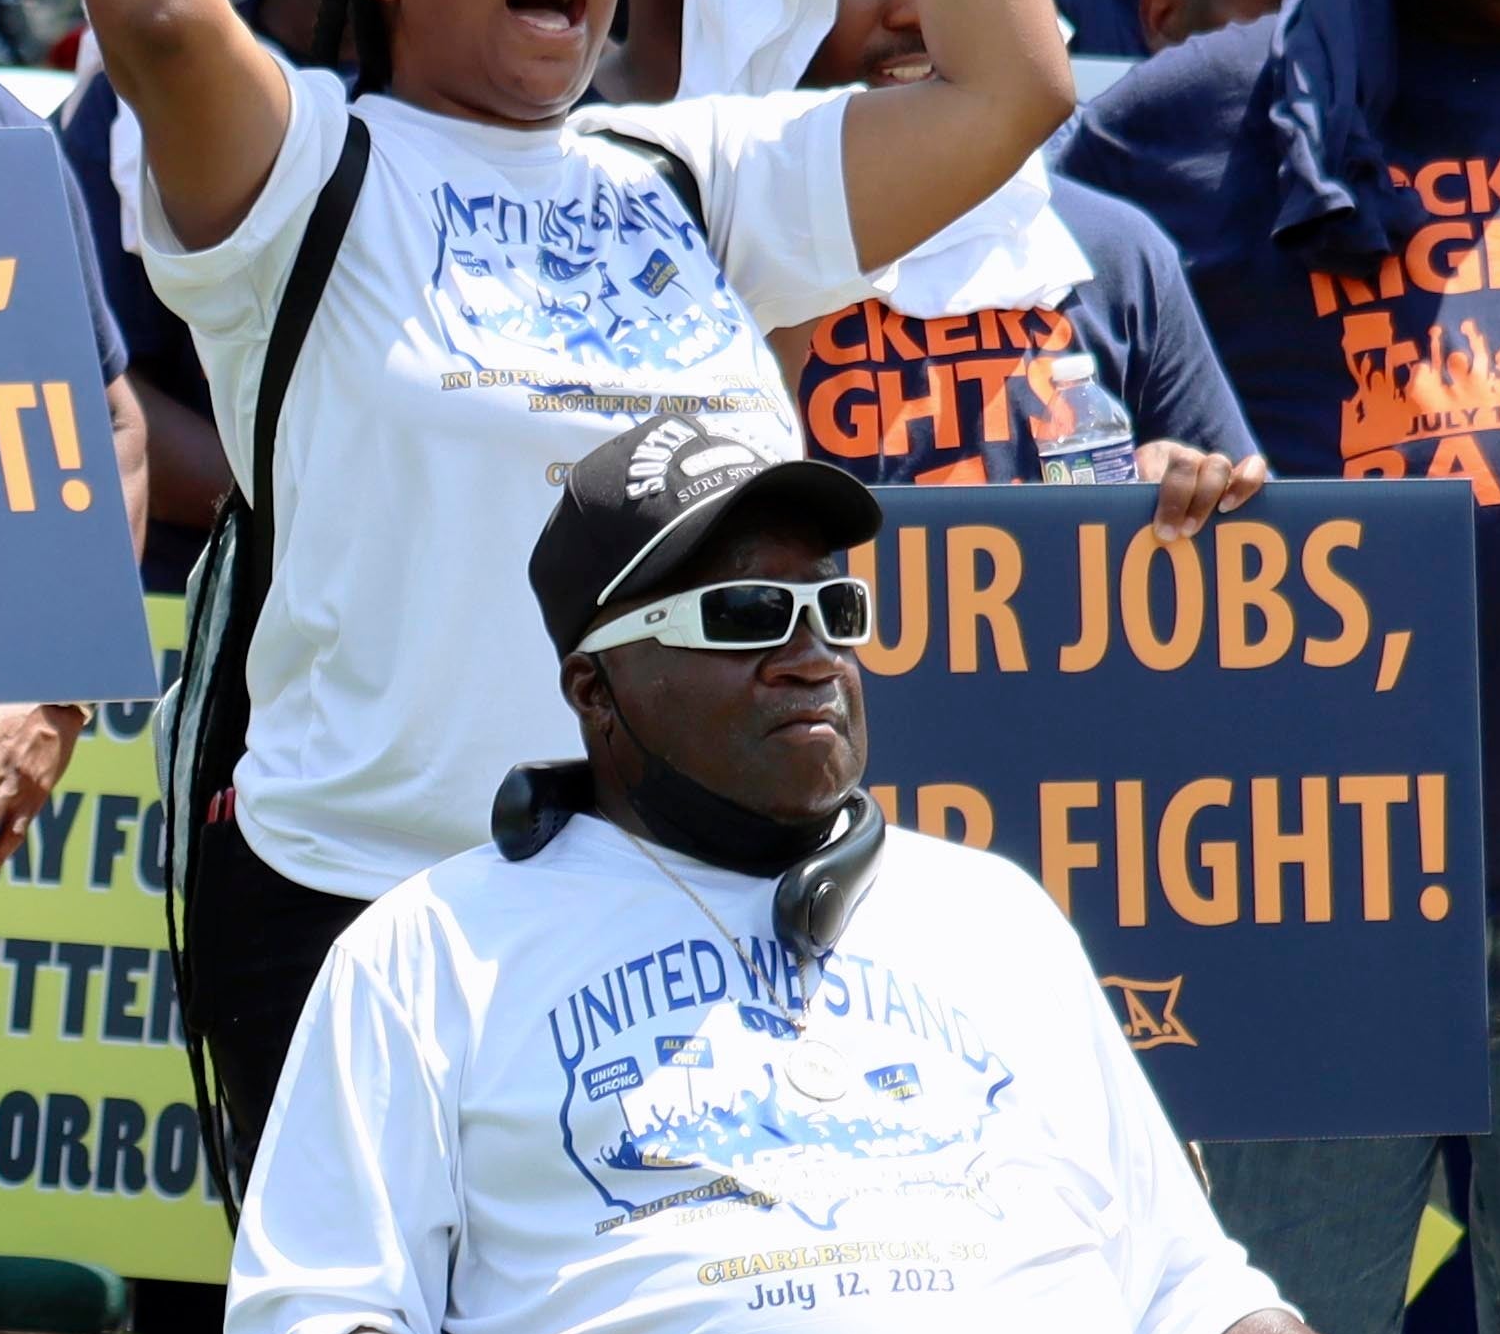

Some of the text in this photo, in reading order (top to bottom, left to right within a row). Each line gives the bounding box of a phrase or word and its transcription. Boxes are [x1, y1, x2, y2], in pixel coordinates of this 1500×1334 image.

[808, 297, 1076, 369] CKERS
[528, 393, 651, 415] BROTHERS
[656, 394, 701, 415] AND
[807, 351, 1078, 460] GHTS
[1405, 406, 1479, 437] JULY
[676, 473, 725, 504] SURF
[843, 518, 1414, 693] UR JOBS,
[1038, 772, 1453, 929] FIGHT!
[547, 938, 729, 1068] UNITED
[733, 936, 804, 1010] WE
[821, 950, 991, 1071] STAND
[590, 1062, 629, 1085] UNION
[590, 1072, 640, 1100] STRONG
[747, 1279, 817, 1312] July
[889, 1268, 956, 1294] 2023
